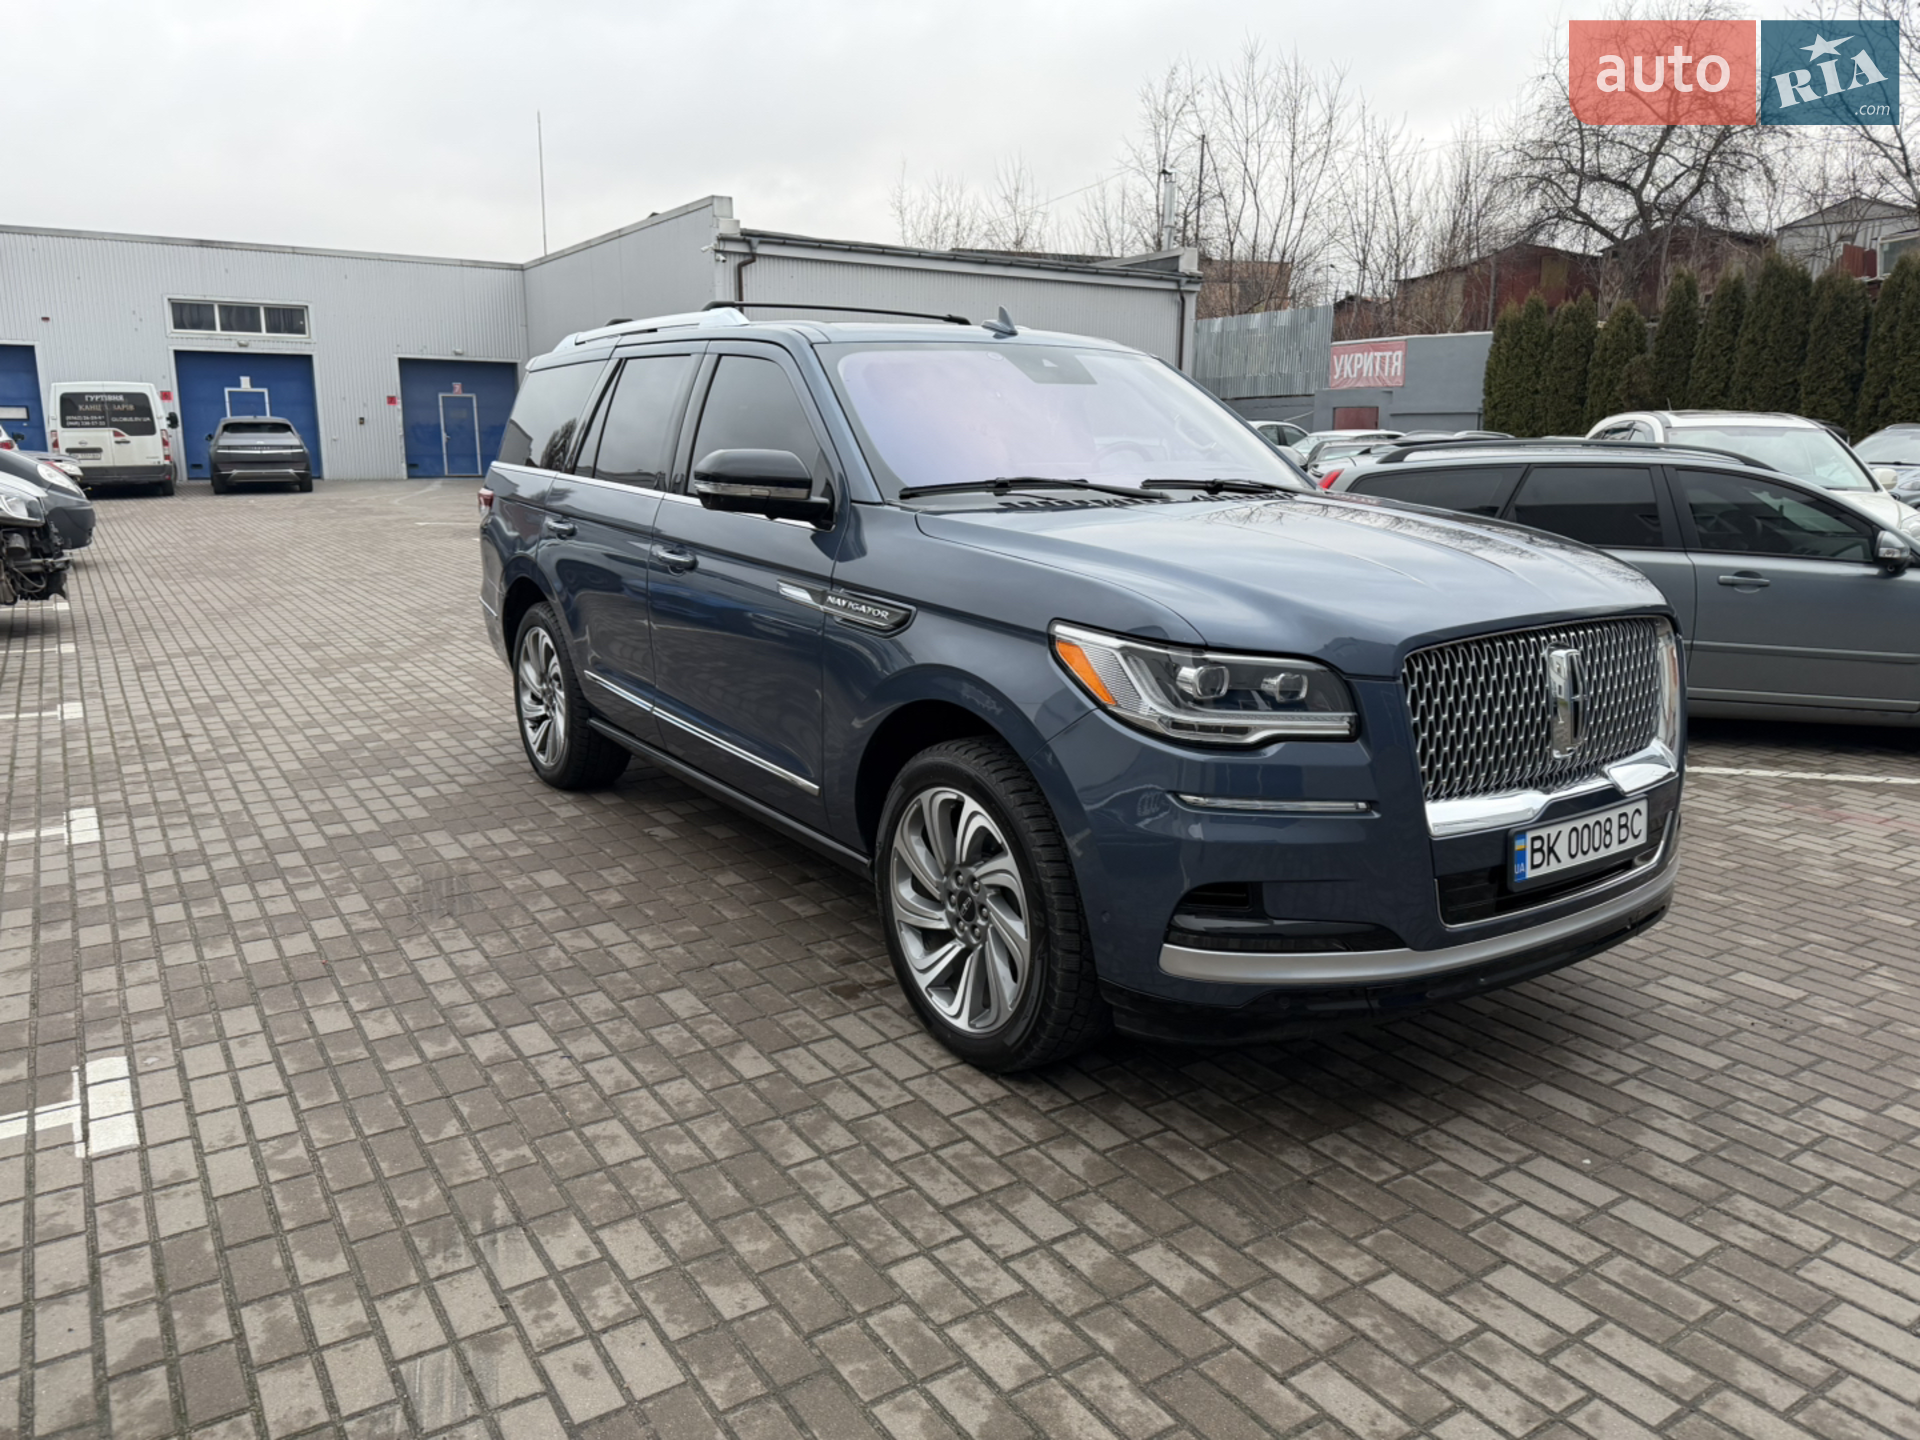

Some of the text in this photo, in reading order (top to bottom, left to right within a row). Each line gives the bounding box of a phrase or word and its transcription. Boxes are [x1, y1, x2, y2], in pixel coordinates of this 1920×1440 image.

[1333, 350, 1404, 380] УКРИТТЯ
[826, 595, 890, 620] NAVIGATOR
[1530, 807, 1643, 870] BK 0008 BC
[1514, 862, 1526, 875] UA
